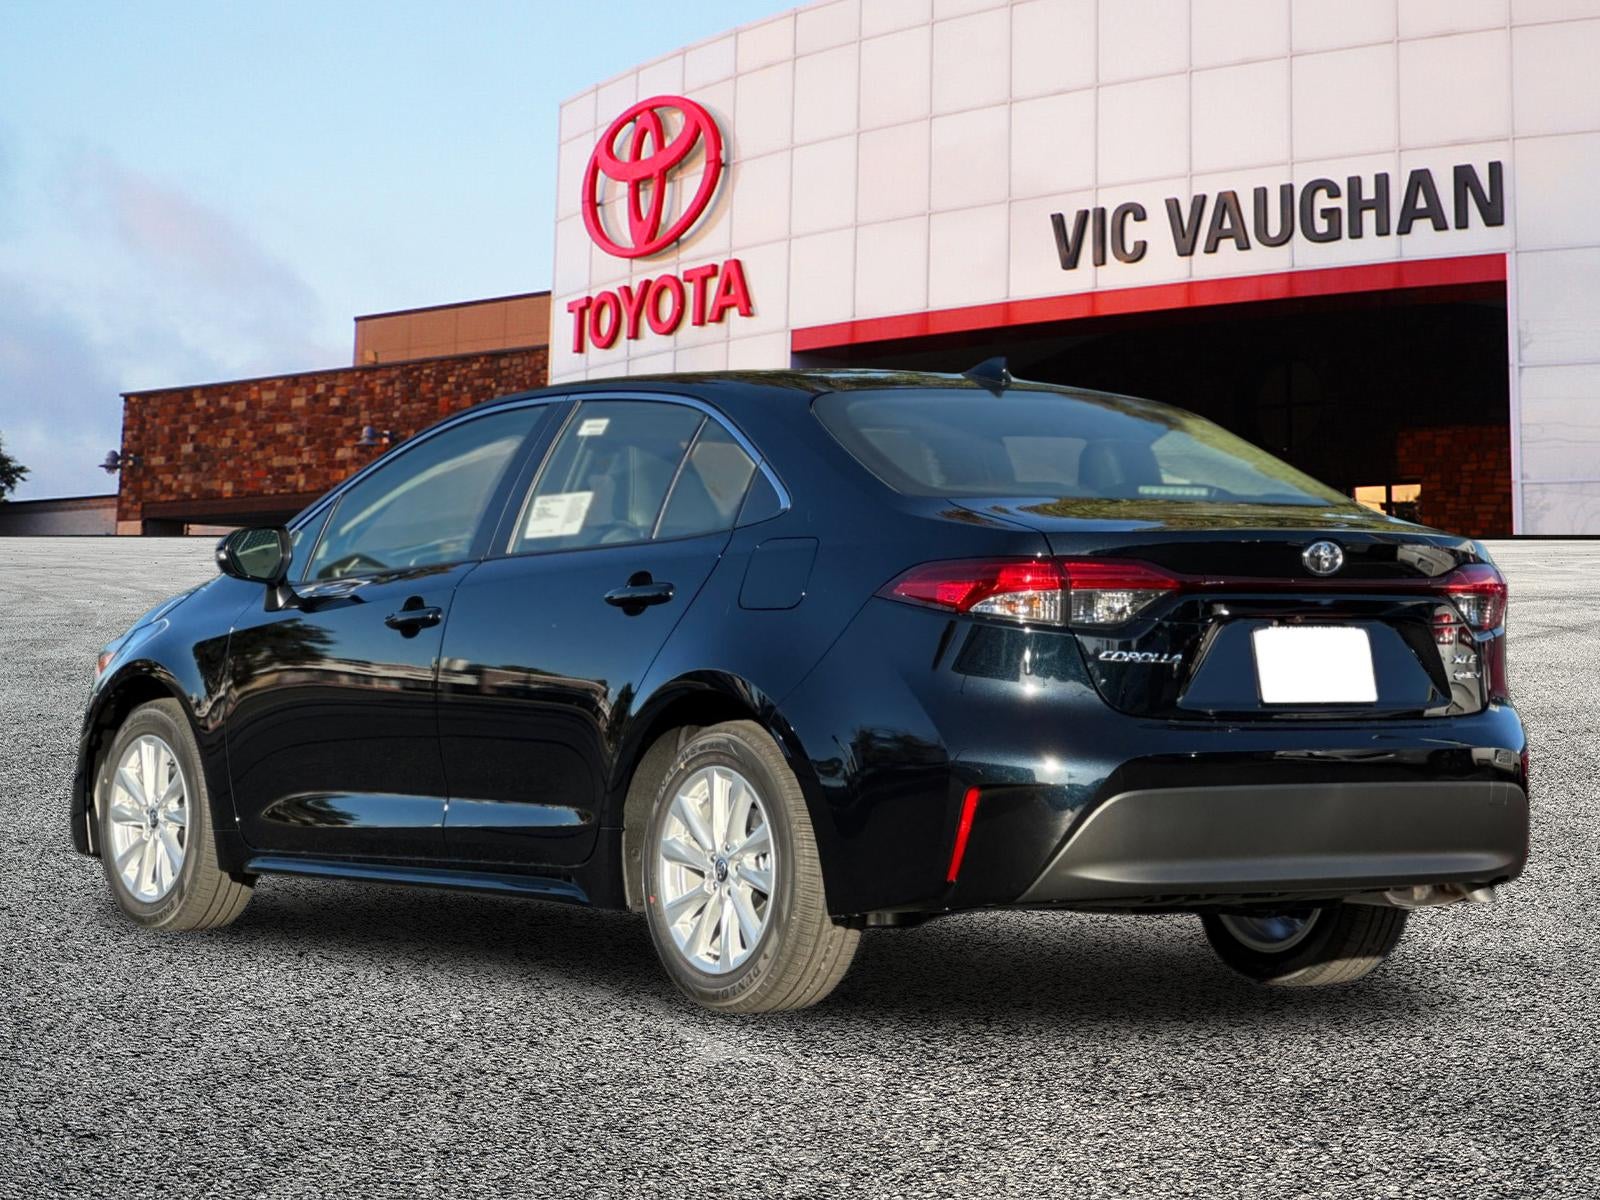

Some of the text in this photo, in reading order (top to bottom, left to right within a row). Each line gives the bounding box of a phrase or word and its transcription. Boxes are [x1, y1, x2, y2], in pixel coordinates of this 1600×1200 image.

[1050, 160, 1505, 270] VIC VAUGHAN
[567, 258, 754, 353] TOYOTA
[1098, 650, 1183, 664] COROLLA
[711, 963, 762, 1001] DUNLOP
